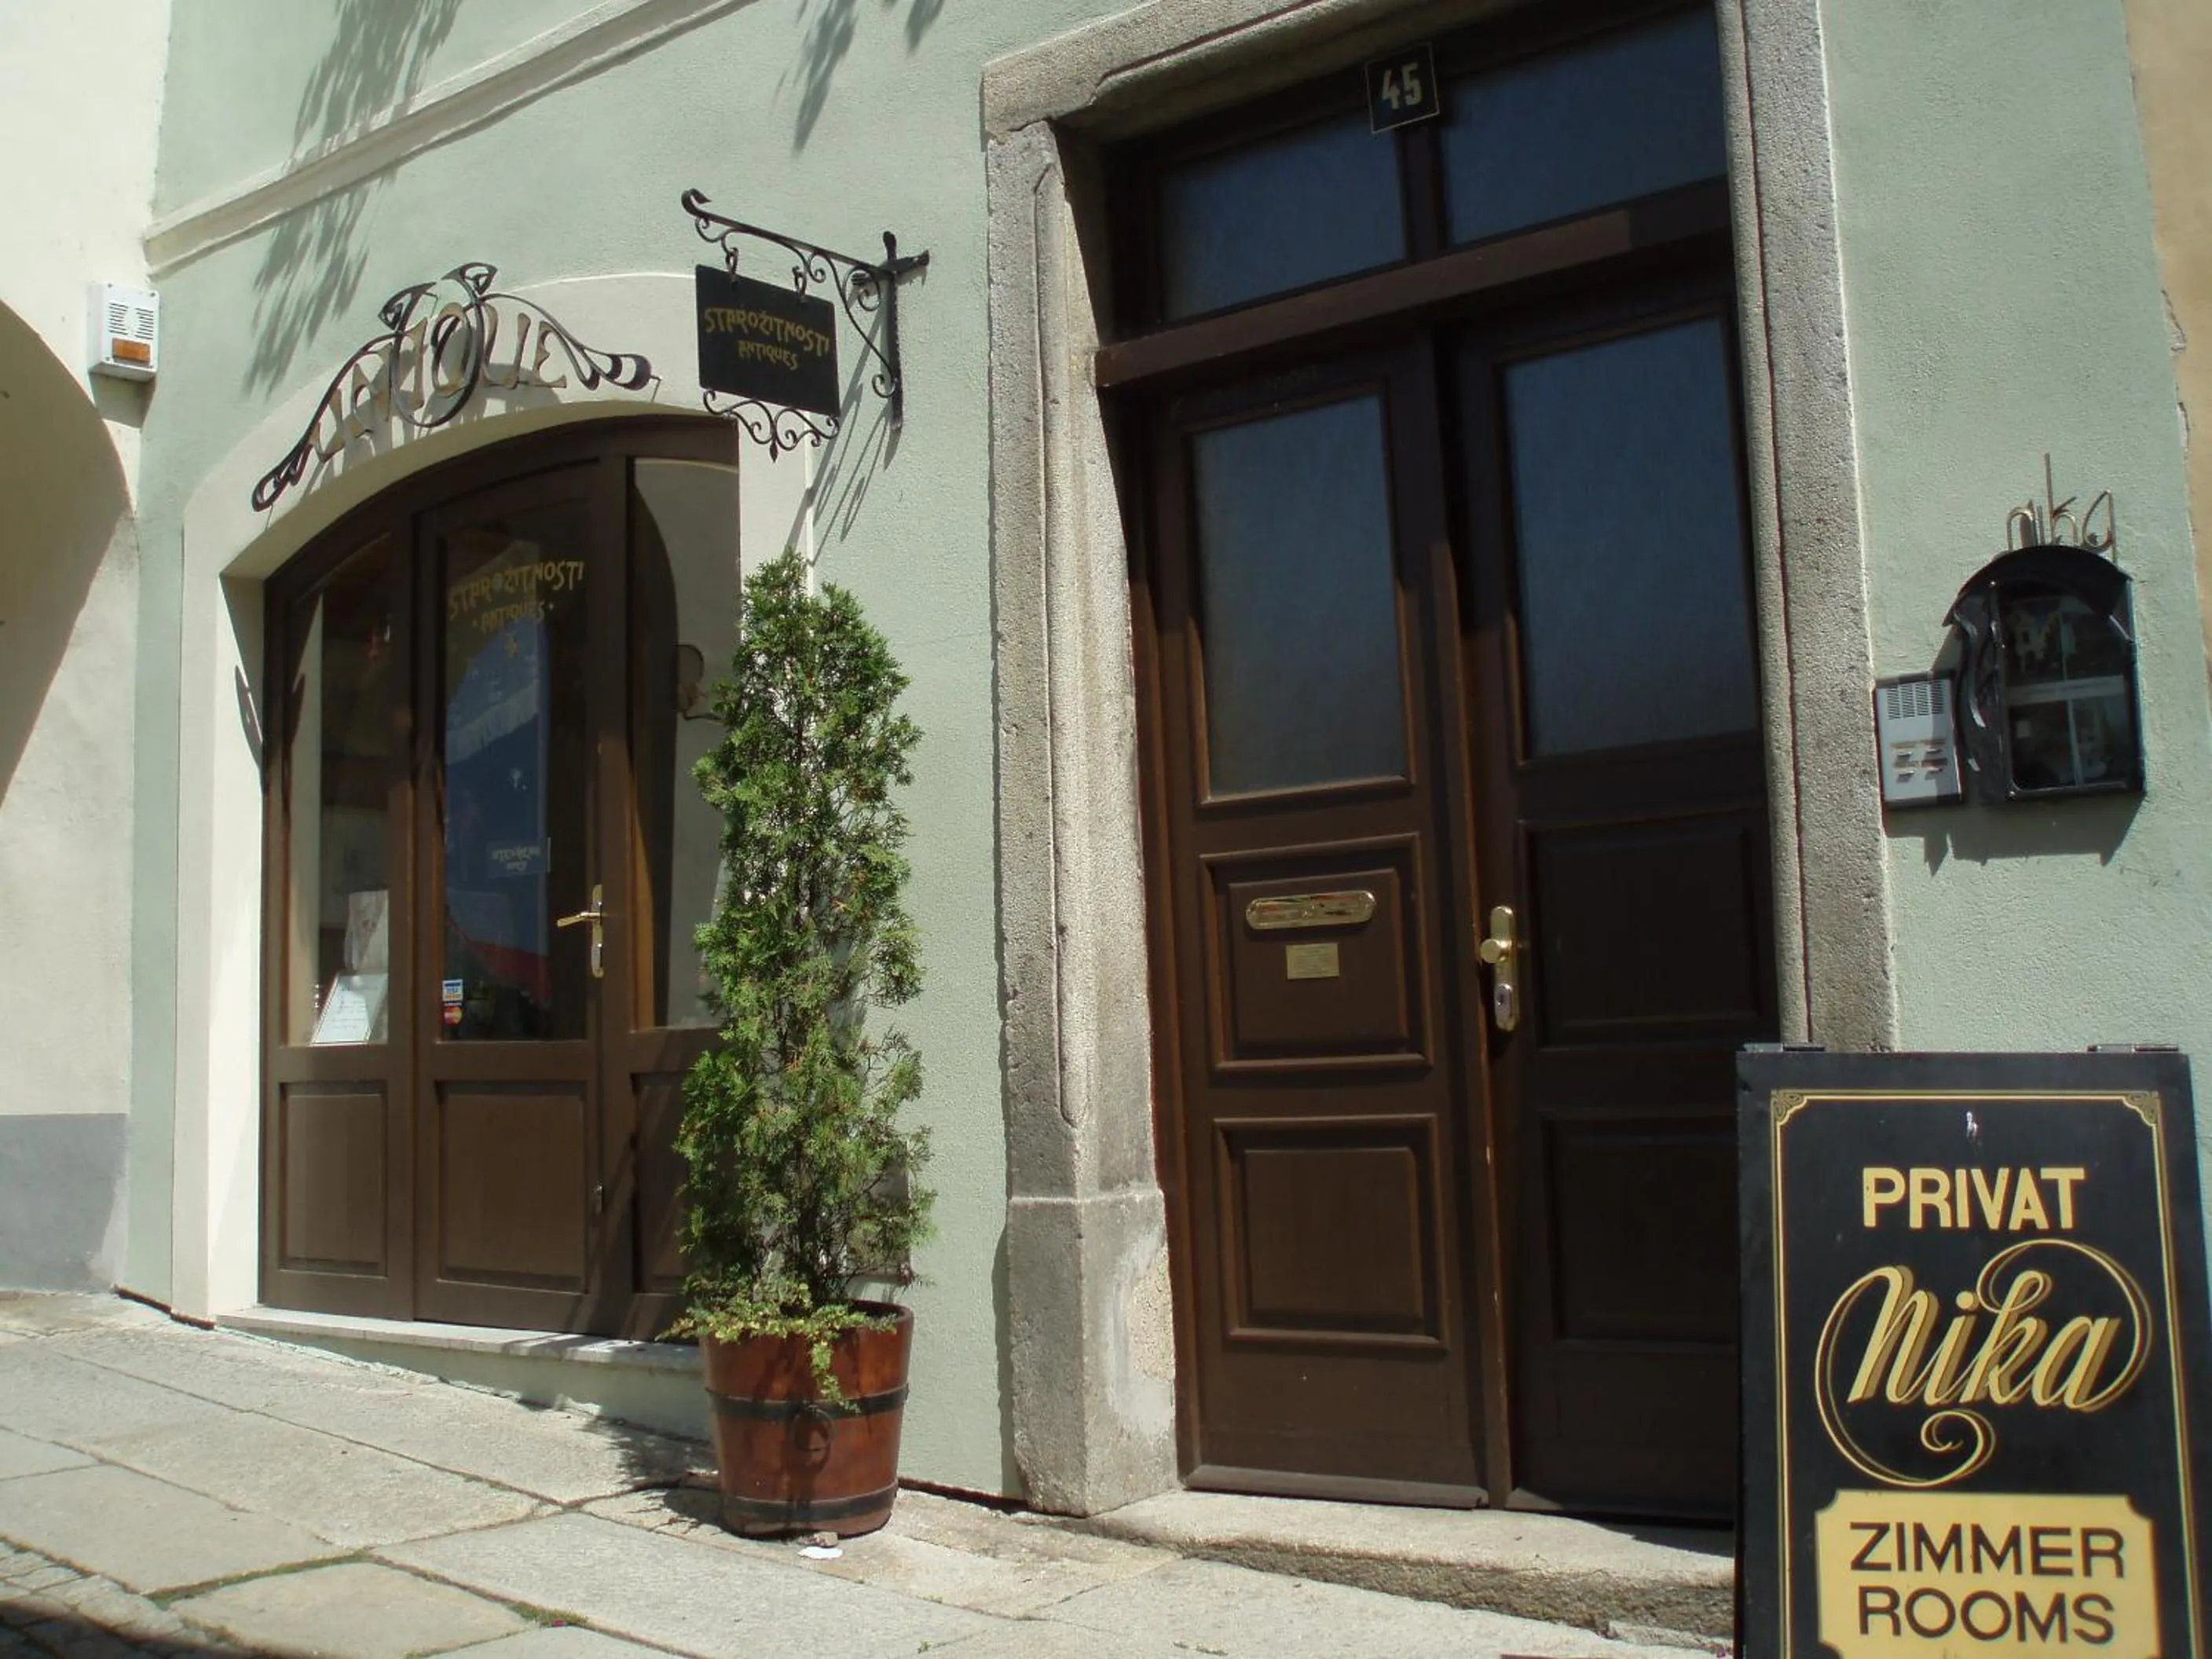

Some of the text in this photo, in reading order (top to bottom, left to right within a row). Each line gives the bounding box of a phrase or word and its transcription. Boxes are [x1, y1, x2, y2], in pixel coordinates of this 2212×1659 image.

[1381, 62, 1422, 110] 45
[737, 339, 799, 371] ANTIQUES
[1862, 1166, 2086, 1231] PRIVAT
[1849, 1521, 2125, 1579] ZIMMER
[1858, 1585, 2115, 1646] ROOMS
